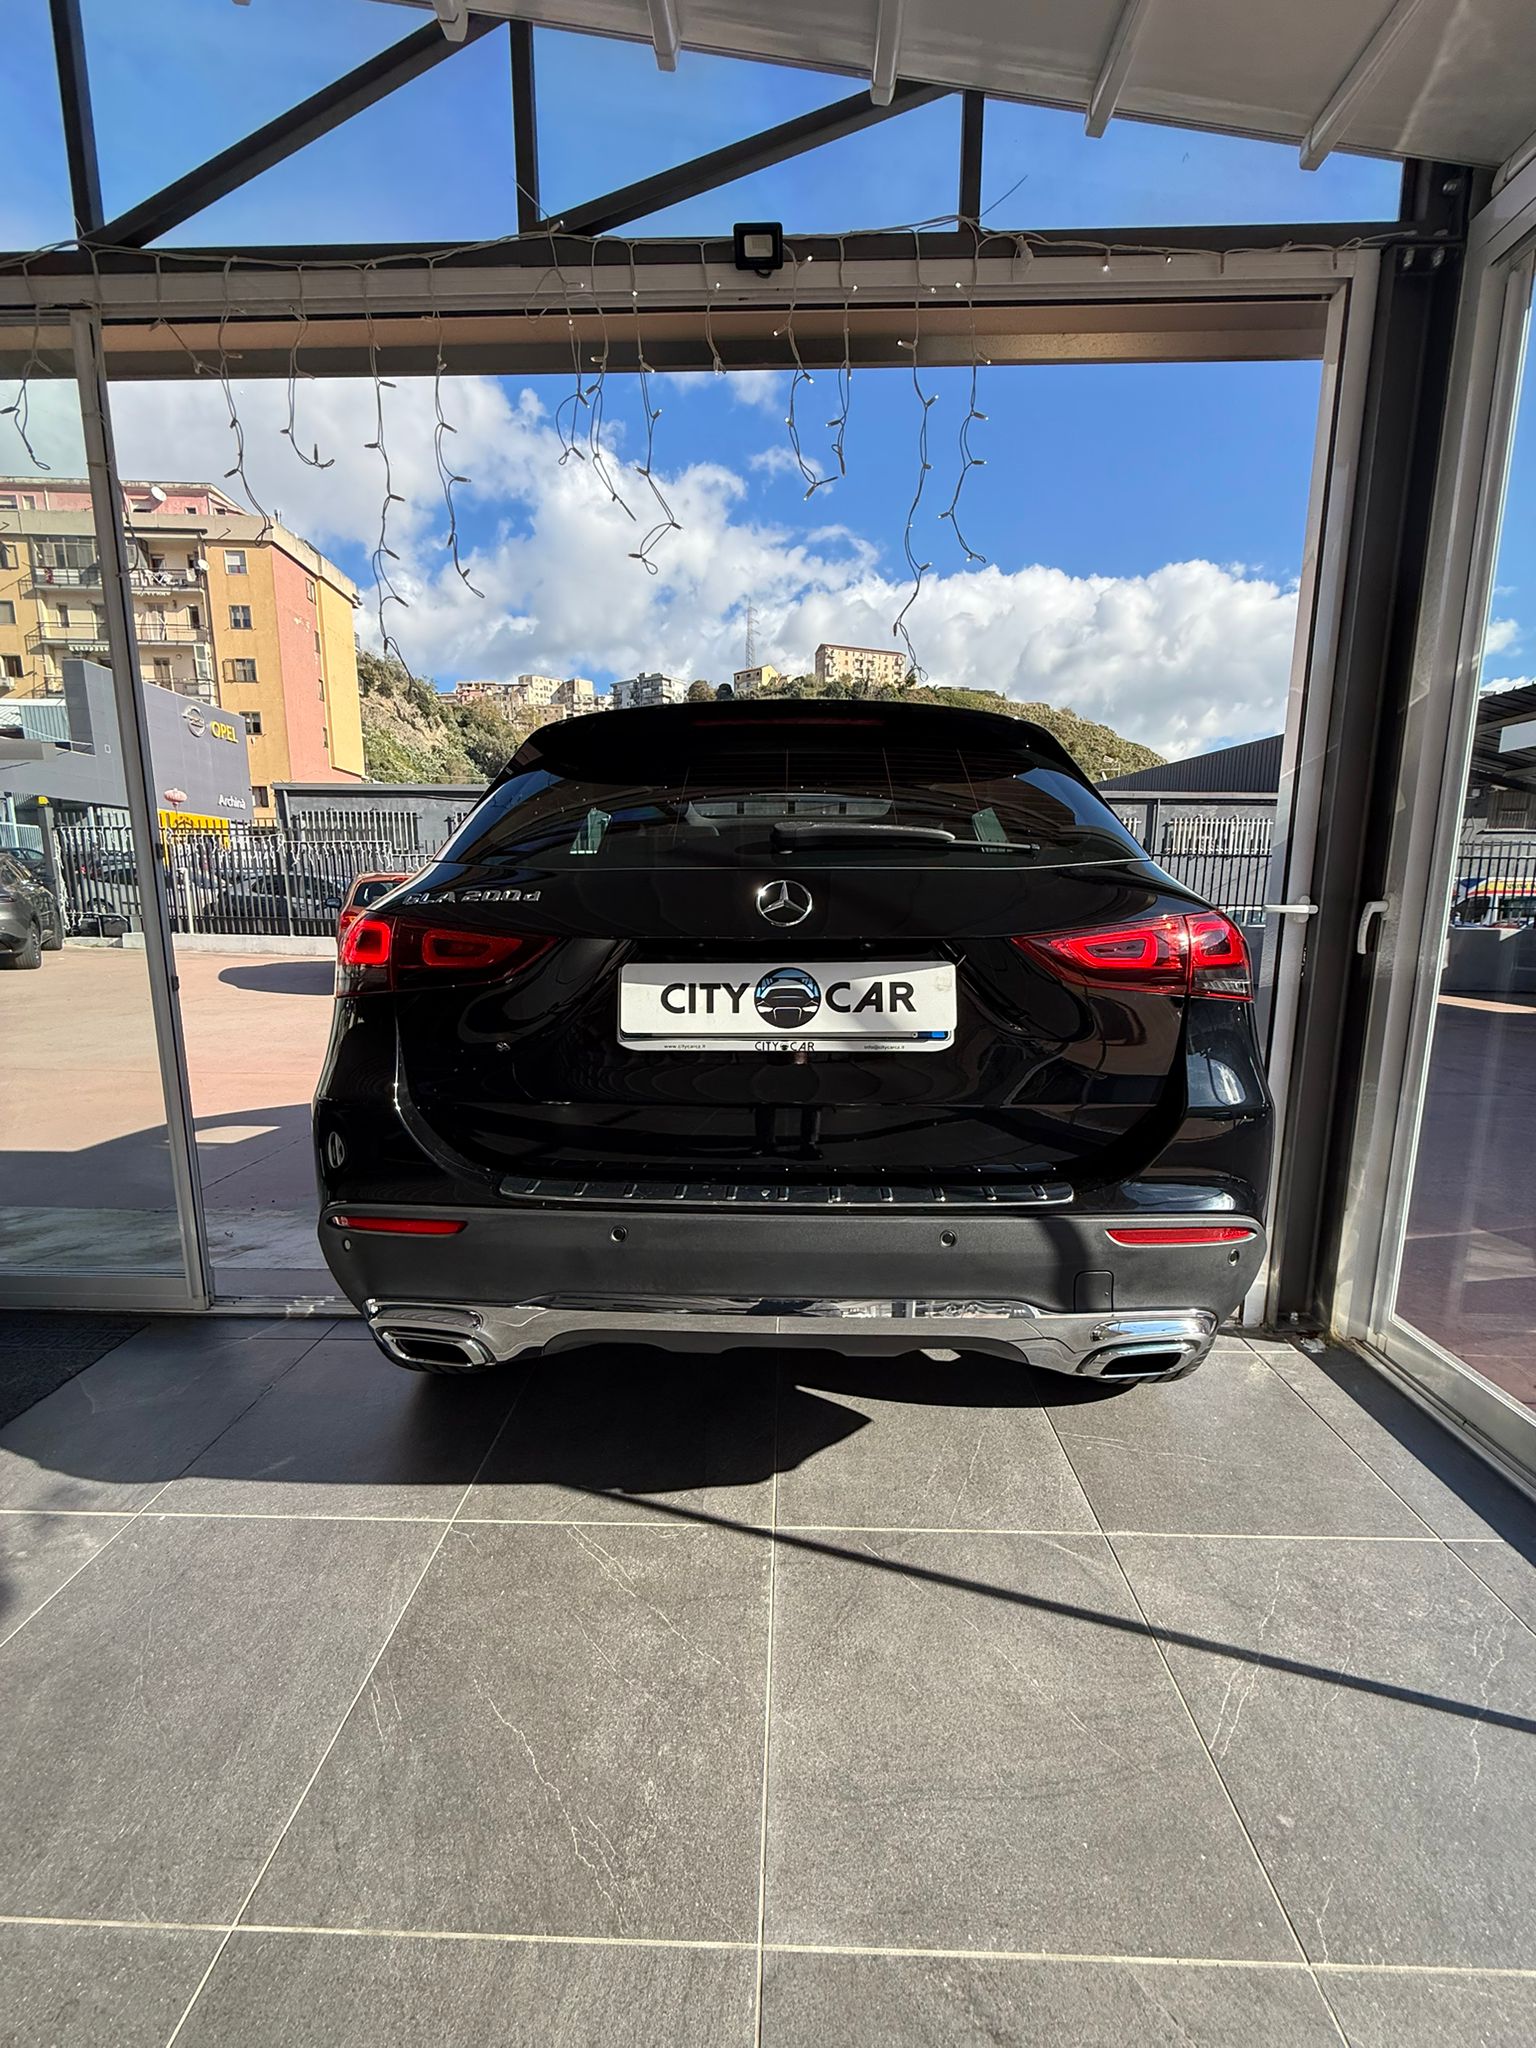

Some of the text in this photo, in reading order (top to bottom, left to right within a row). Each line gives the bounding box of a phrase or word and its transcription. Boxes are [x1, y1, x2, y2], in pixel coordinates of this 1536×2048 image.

[210, 721, 239, 744] OPEL
[402, 892, 456, 905] GLA
[660, 982, 916, 1014] CITY CAR
[754, 1041, 815, 1051] CITY CAR
